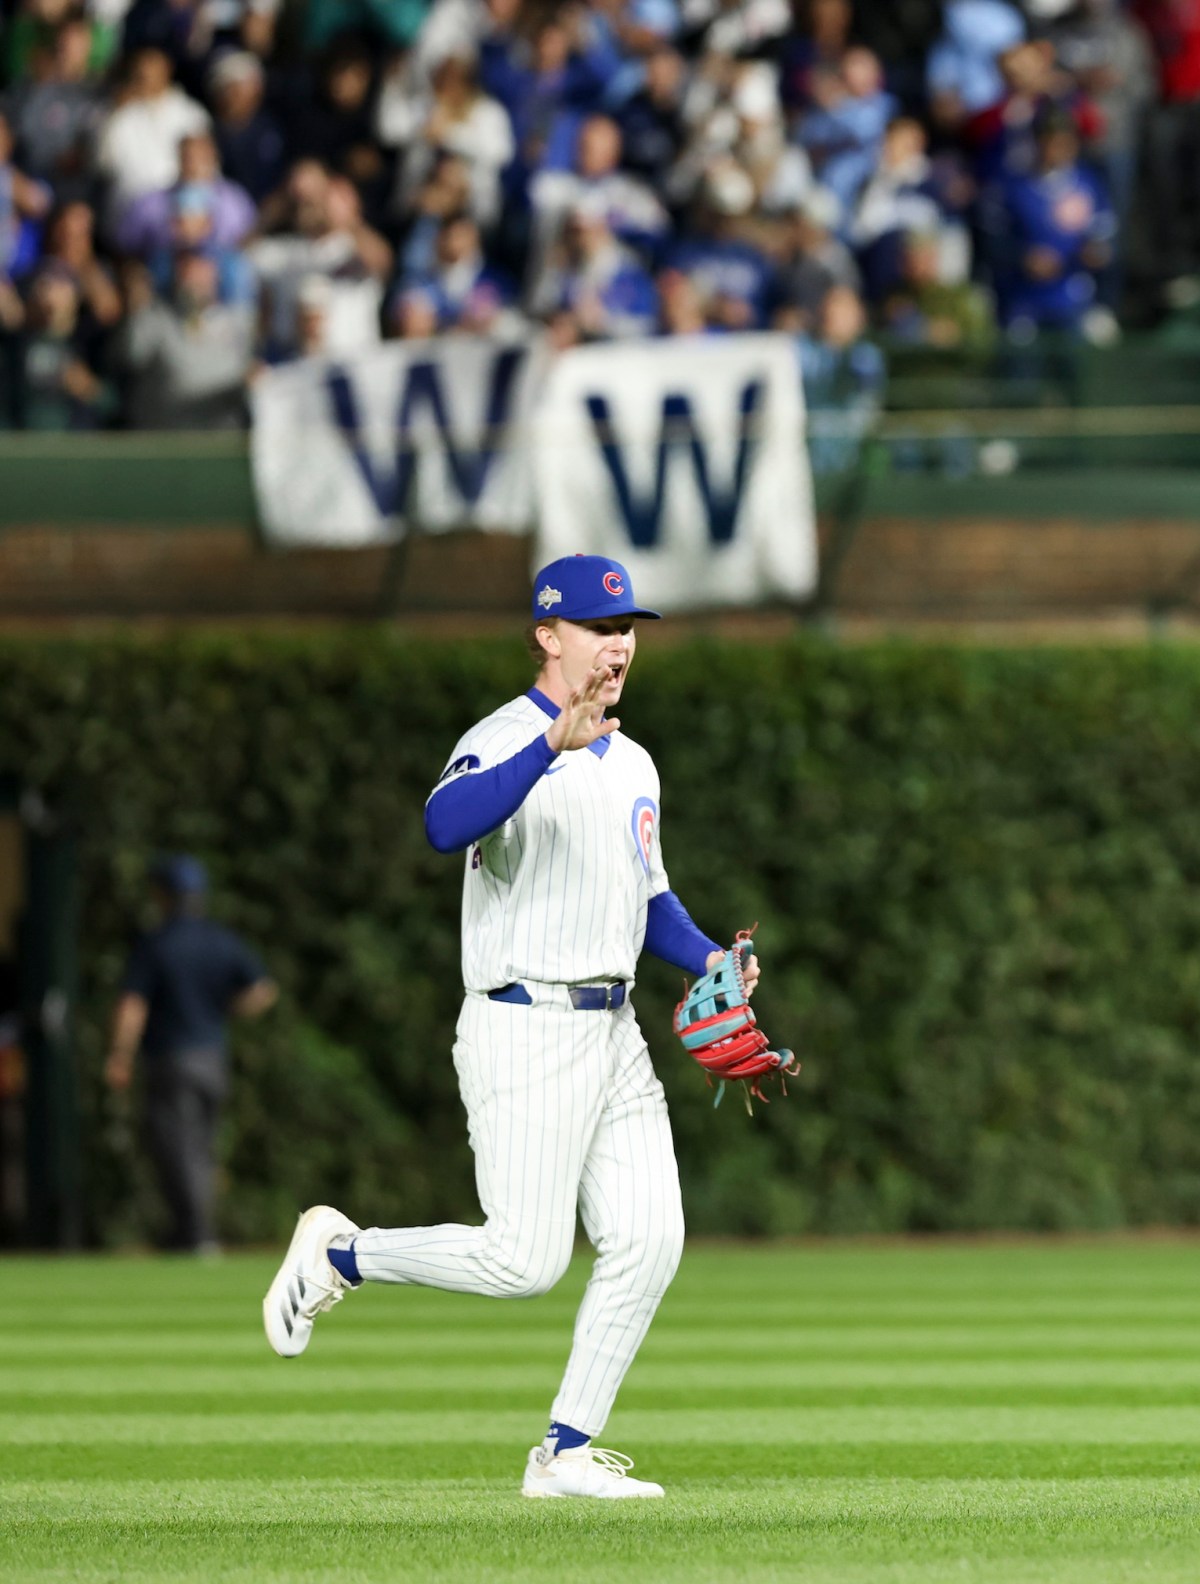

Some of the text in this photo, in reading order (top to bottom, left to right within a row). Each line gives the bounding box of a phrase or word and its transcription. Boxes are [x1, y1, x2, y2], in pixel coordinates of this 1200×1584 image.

[325, 346, 526, 520] W
[584, 379, 766, 548] W
[602, 571, 624, 596] C
